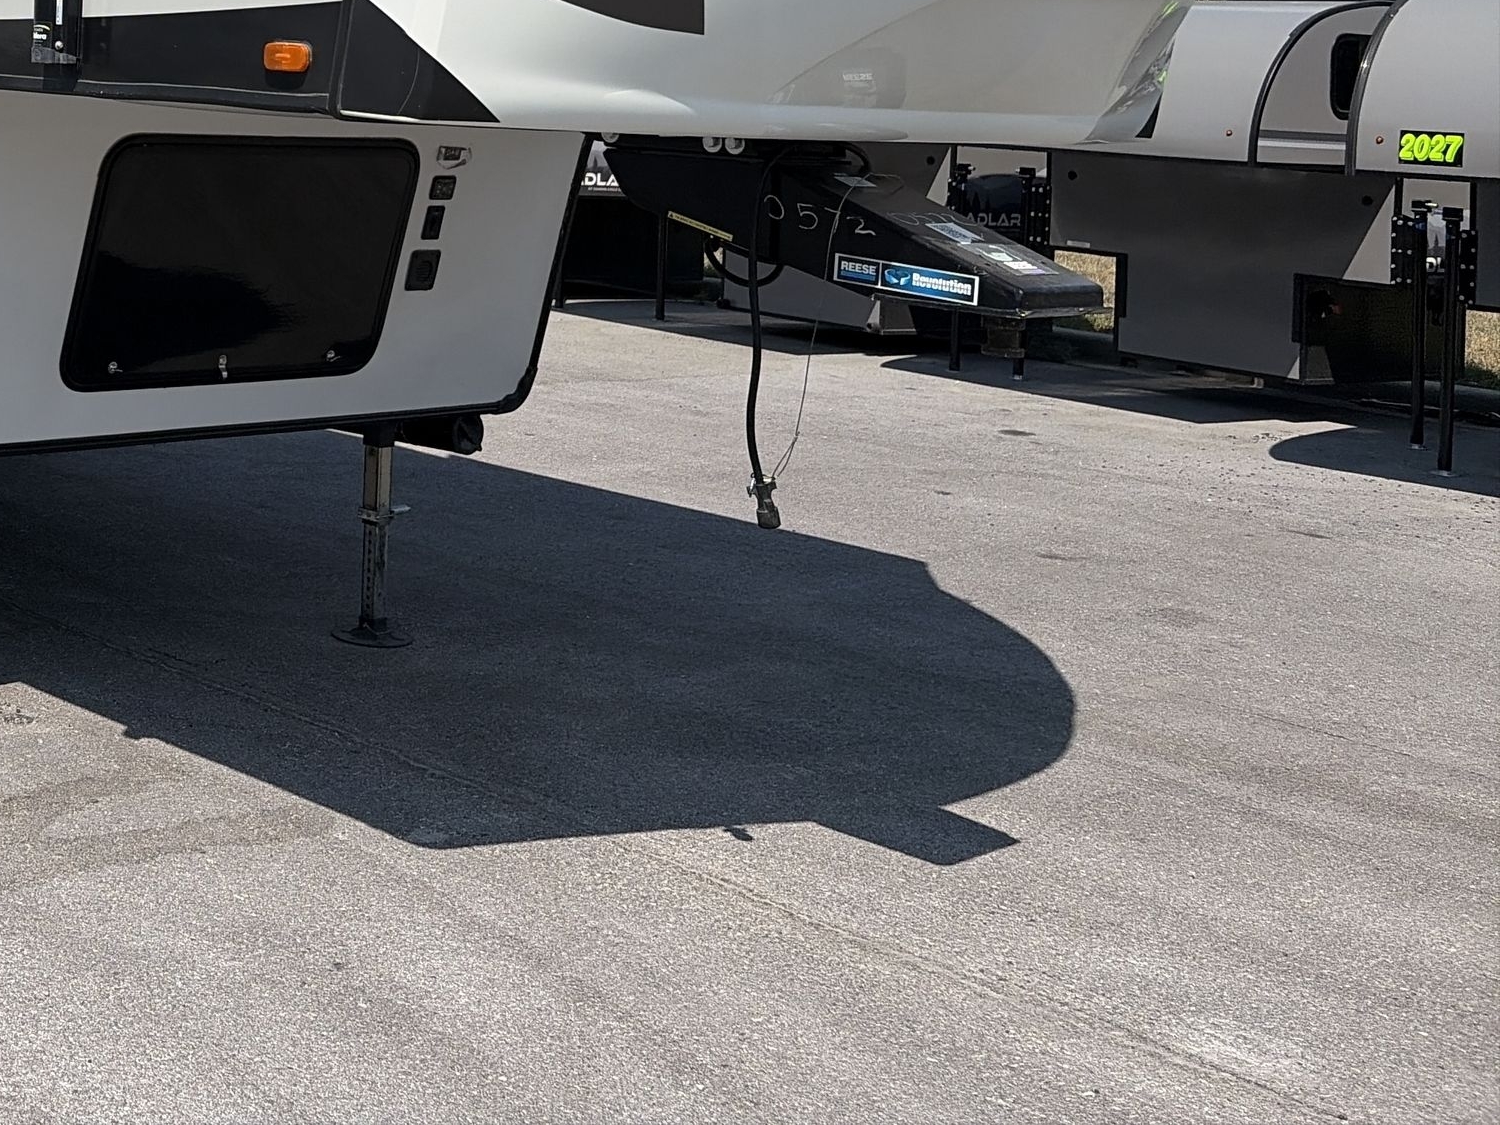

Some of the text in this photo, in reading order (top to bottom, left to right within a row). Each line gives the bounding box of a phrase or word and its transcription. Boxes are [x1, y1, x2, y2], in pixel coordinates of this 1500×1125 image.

[1398, 133, 1464, 163] 2027
[840, 260, 877, 276] REESE
[911, 272, 972, 296] Revolution
